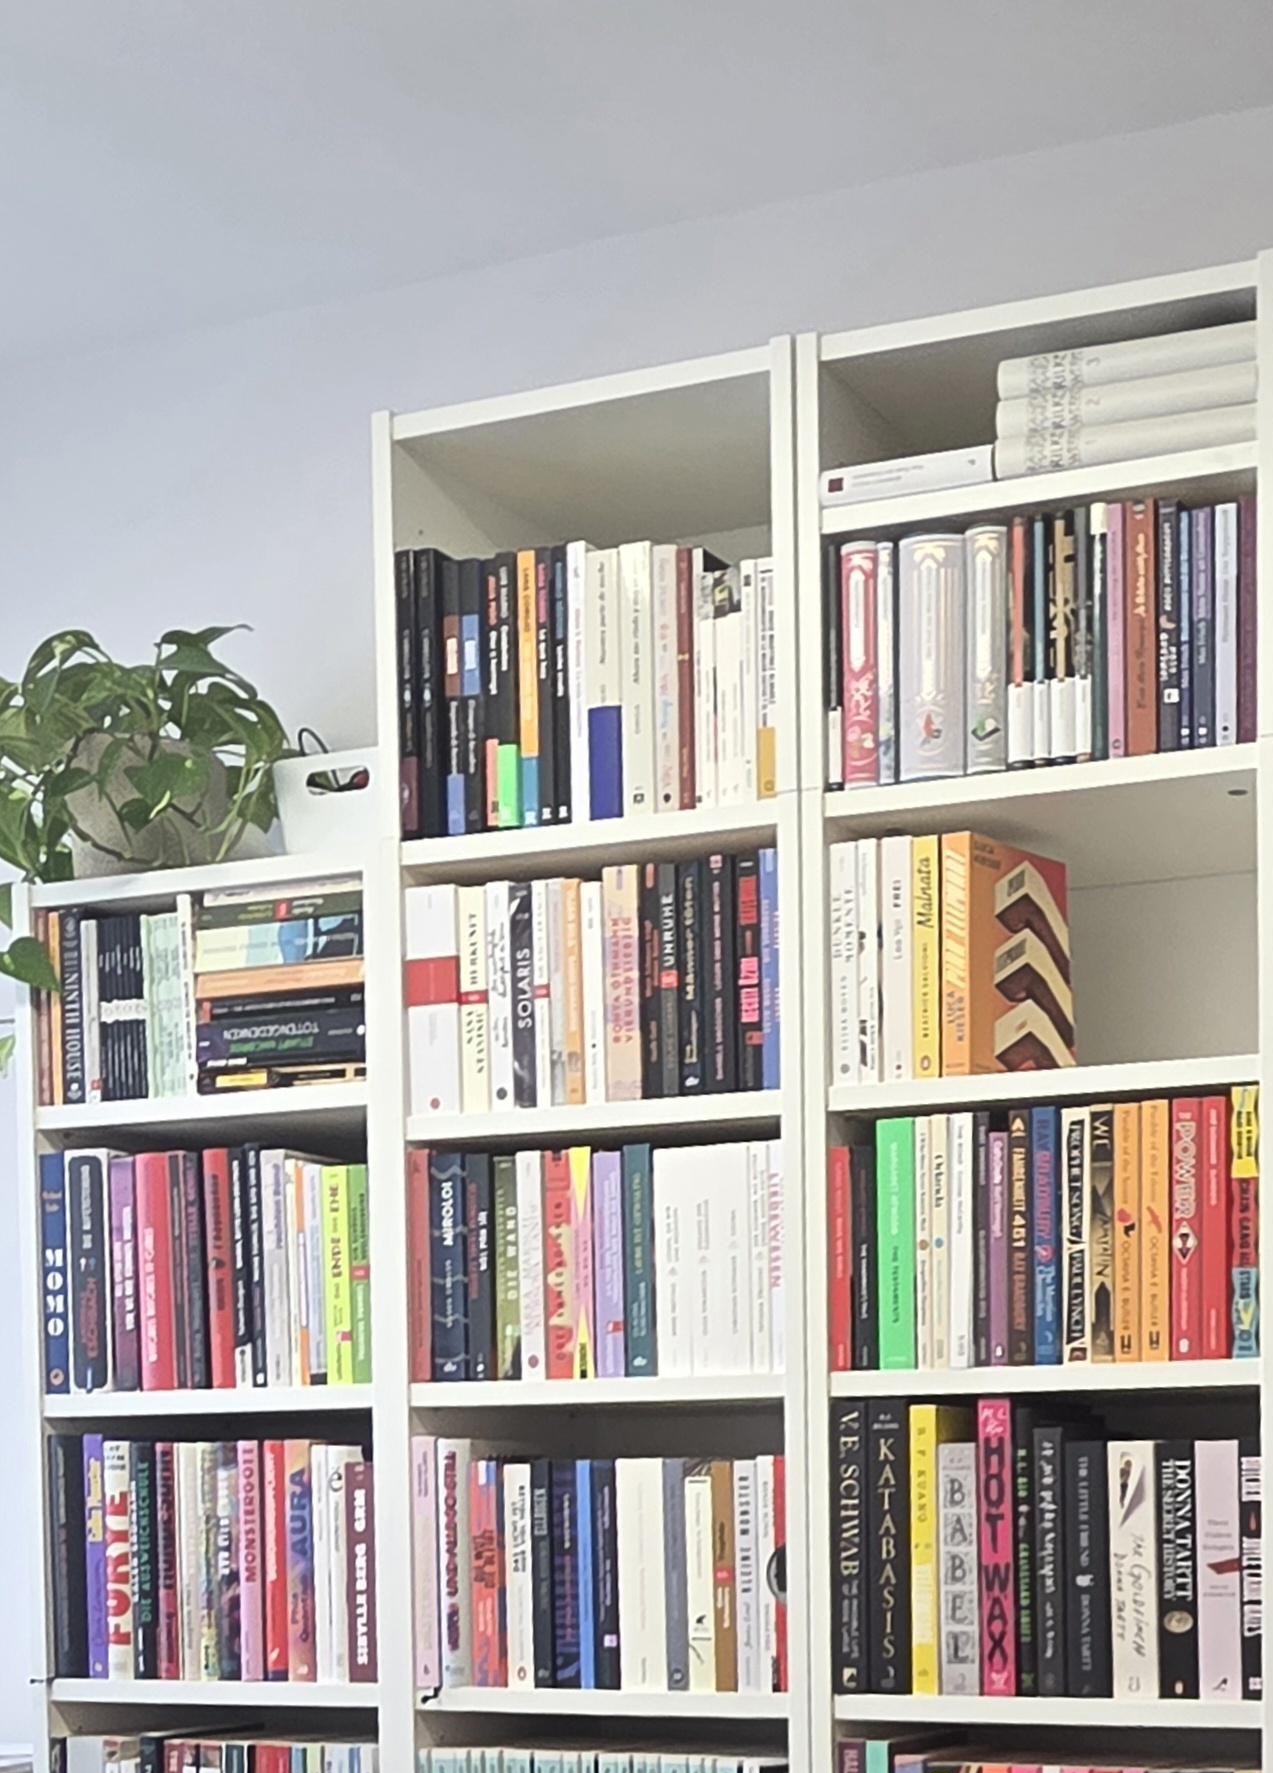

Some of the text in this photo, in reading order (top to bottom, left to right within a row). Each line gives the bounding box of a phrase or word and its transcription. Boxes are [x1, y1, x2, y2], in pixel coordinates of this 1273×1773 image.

[660, 893, 674, 967] UNRUHE
[914, 857, 935, 929] Malnata
[516, 948, 532, 1029] SOLARIS
[65, 1028, 80, 1079] HOUSE
[45, 1248, 64, 1337] MOMO
[290, 1466, 308, 1558] AURA
[839, 1465, 860, 1577] SCHWAB
[878, 1438, 896, 1659] KATABASIS
[983, 1436, 1009, 1671] HOT WAX
[1161, 1458, 1177, 1601] THE SECRET HISTORY
[1175, 1459, 1193, 1603] DONNA TARTT
[944, 1475, 973, 1664] BABEL
